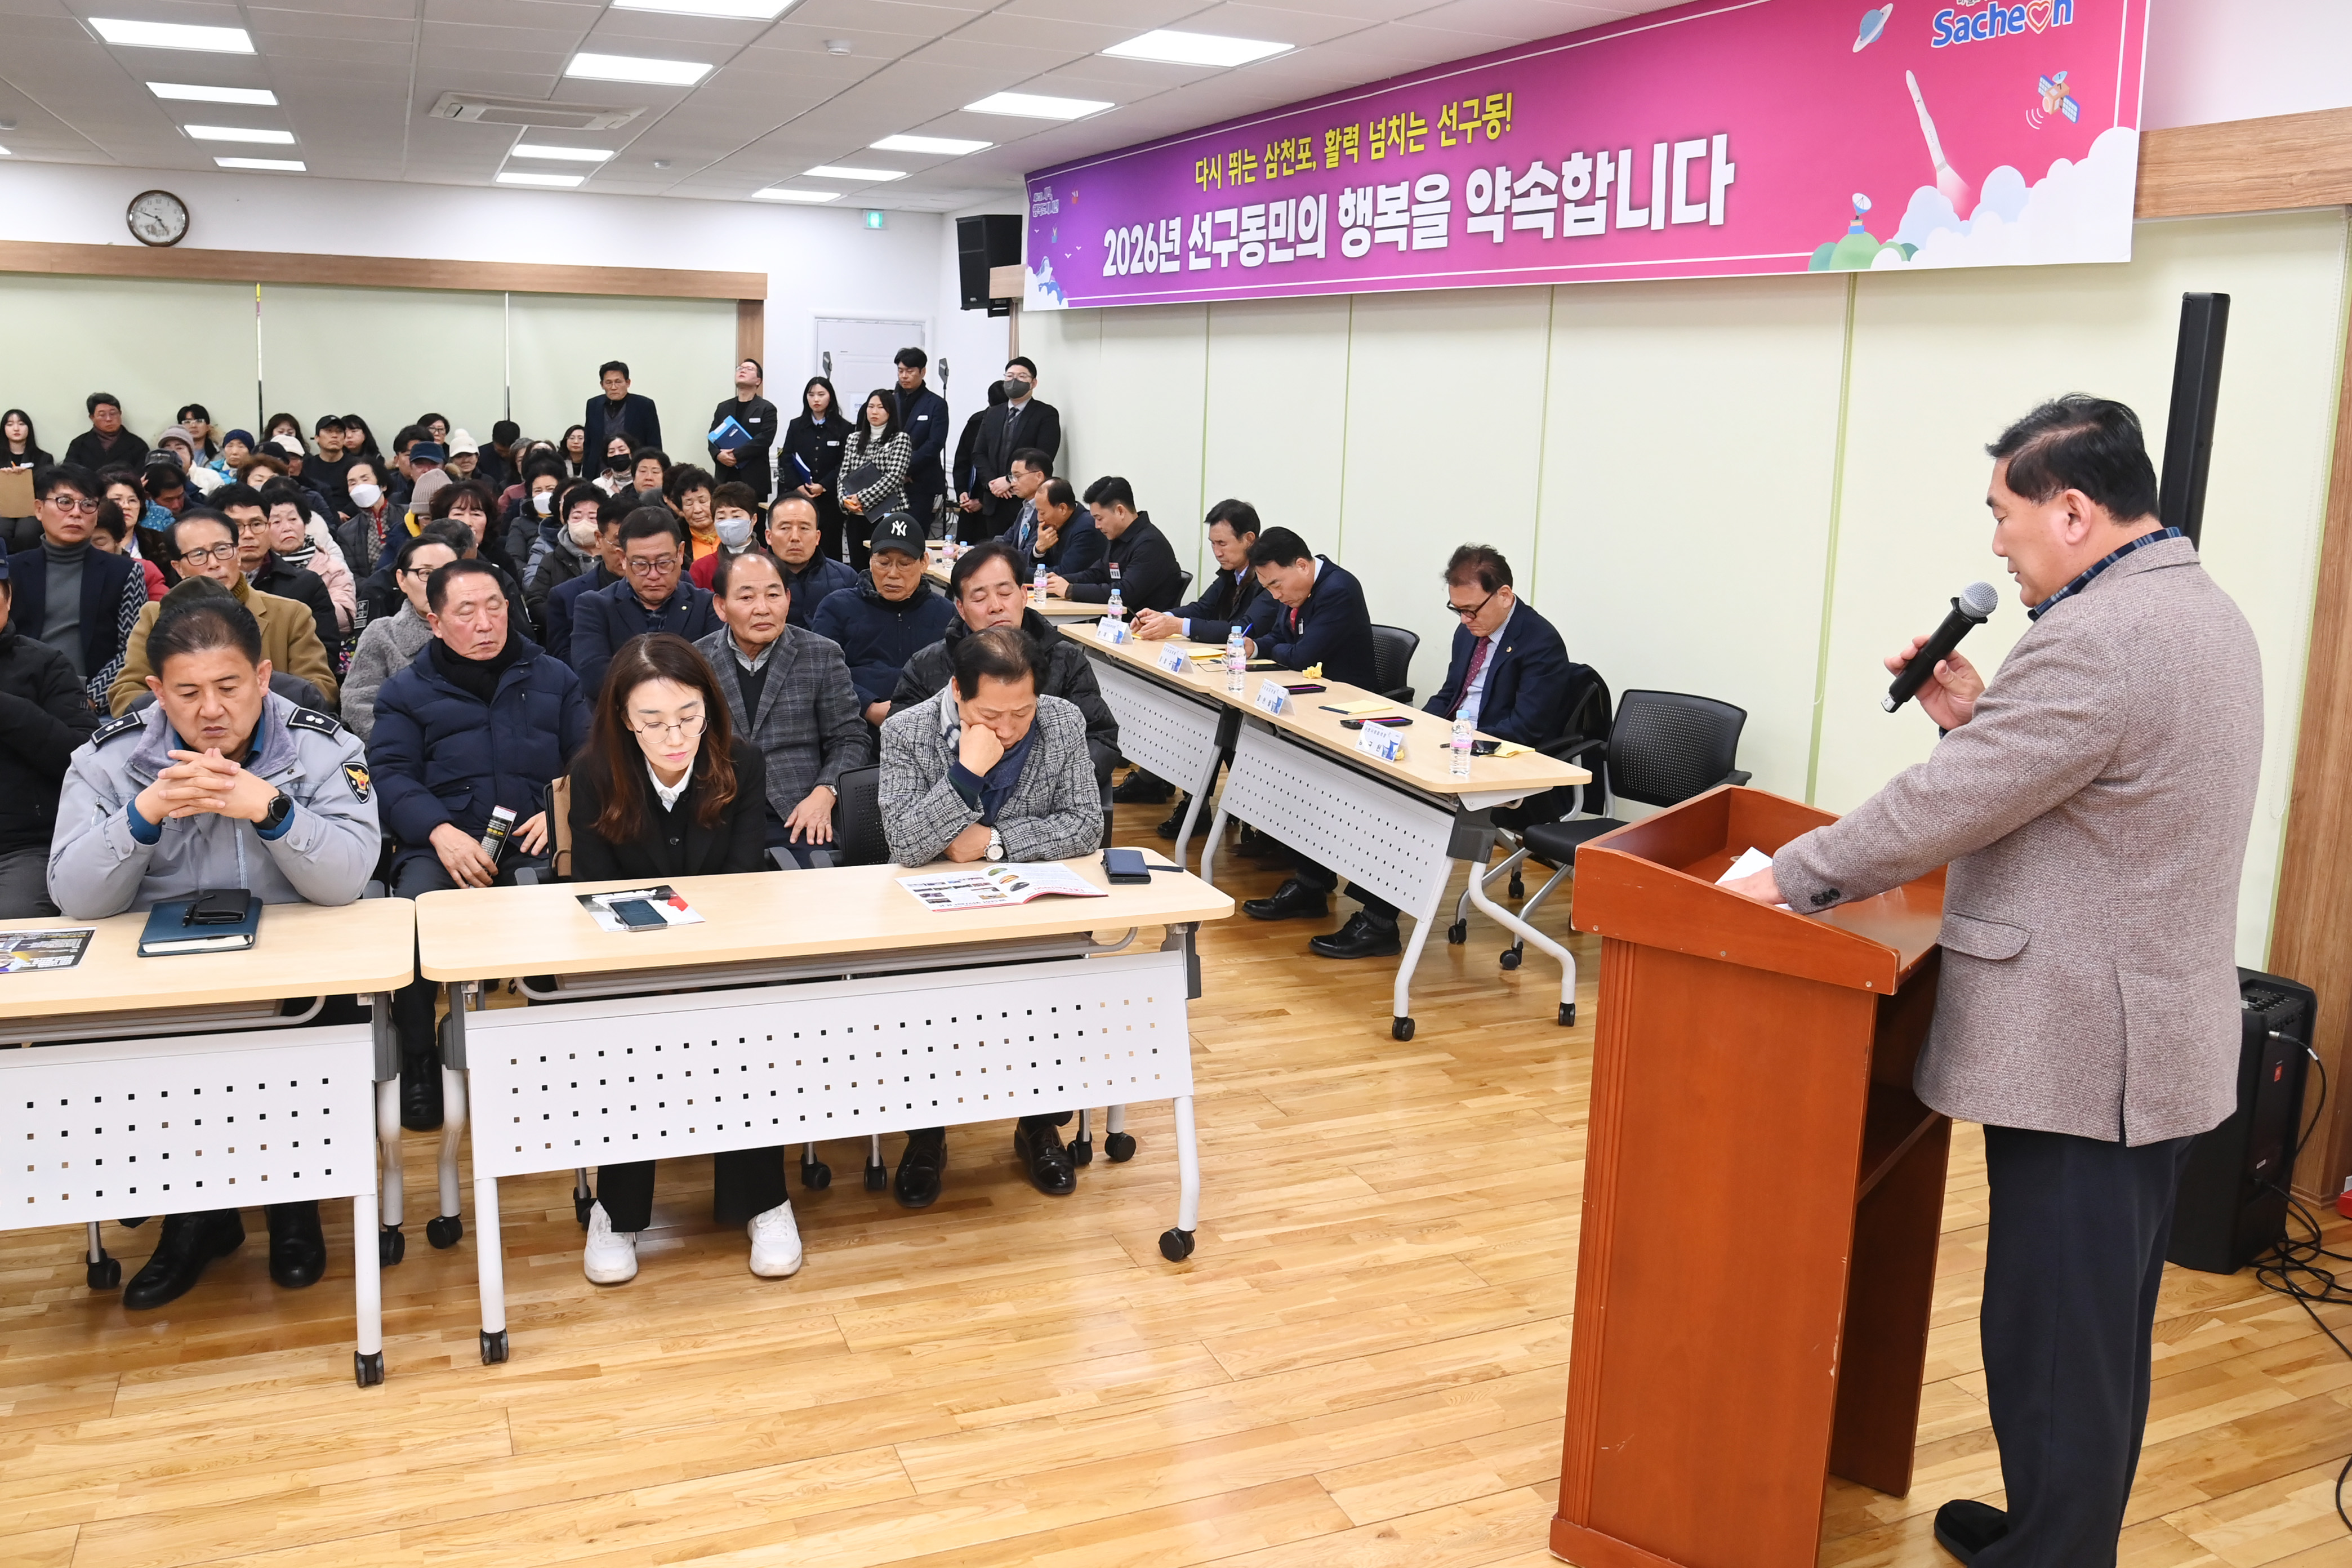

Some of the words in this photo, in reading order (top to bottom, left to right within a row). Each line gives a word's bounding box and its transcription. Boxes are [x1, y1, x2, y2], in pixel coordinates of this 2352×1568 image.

[1196, 157, 1222, 191] 다시
[1229, 149, 1259, 186] 뛰는
[1264, 136, 1318, 180] 삼천포,
[1325, 123, 1360, 169] 활력
[1370, 112, 1429, 161] 넘치는
[1438, 92, 1513, 146] 선구동!
[1102, 216, 1182, 277] 2026년
[1188, 193, 1329, 271] 선구동민의
[1338, 173, 1452, 259] 행복을
[1465, 133, 1736, 244] 약속합니다
[890, 520, 907, 537] NY
